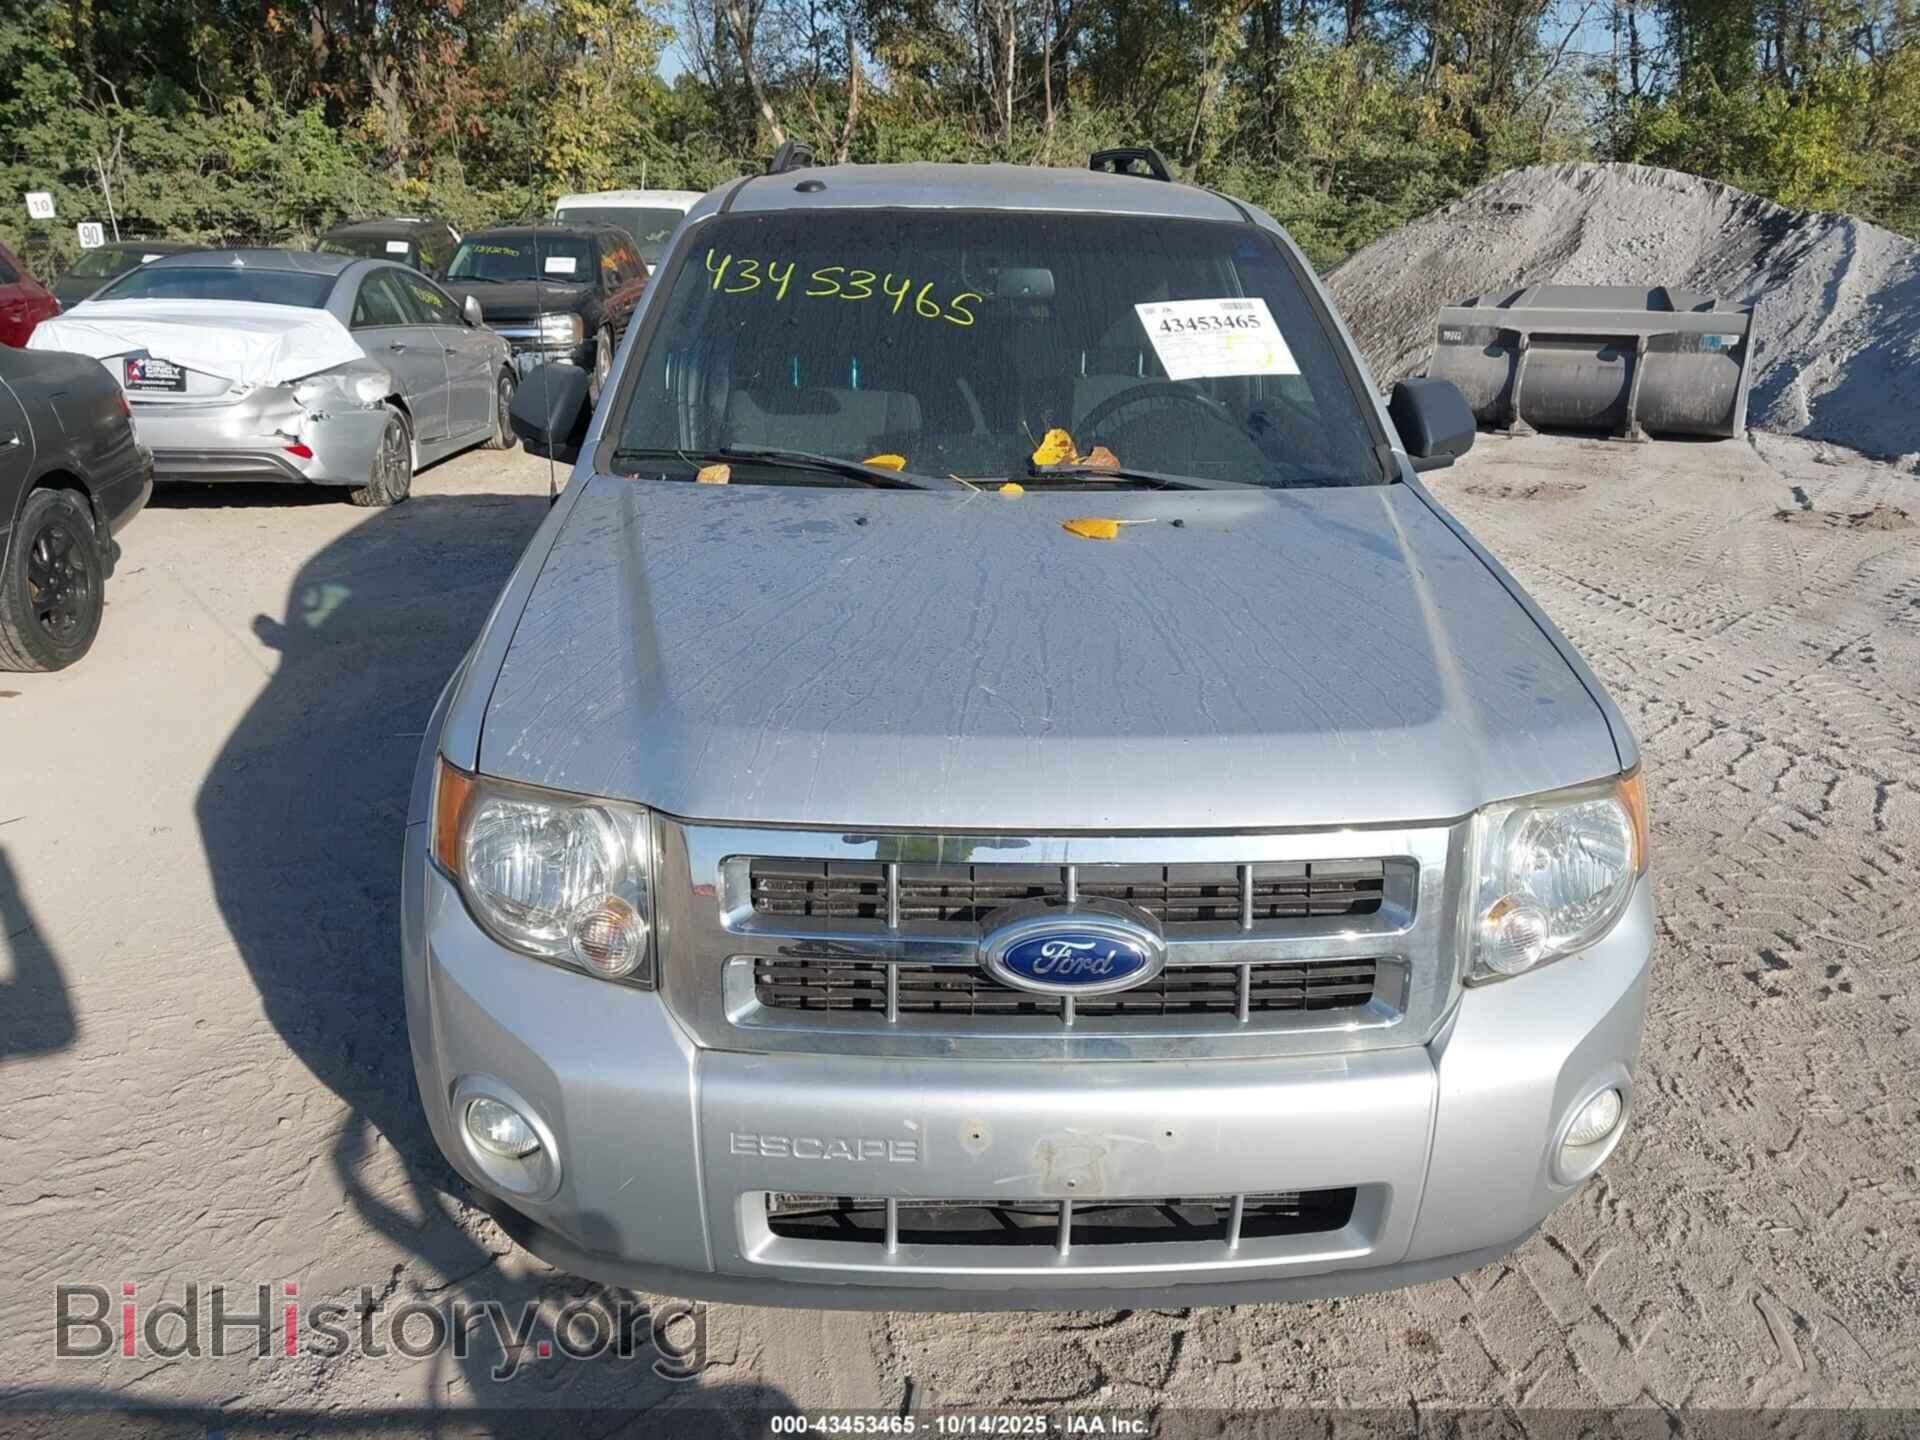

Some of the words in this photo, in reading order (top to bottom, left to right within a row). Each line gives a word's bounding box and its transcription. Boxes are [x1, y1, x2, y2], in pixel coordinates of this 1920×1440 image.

[33, 200, 49, 212] 10
[82, 226, 99, 245] 90
[1159, 315, 1261, 332] 43453465
[1033, 940, 1116, 974] Ford
[730, 1132, 919, 1162] ESCAPE
